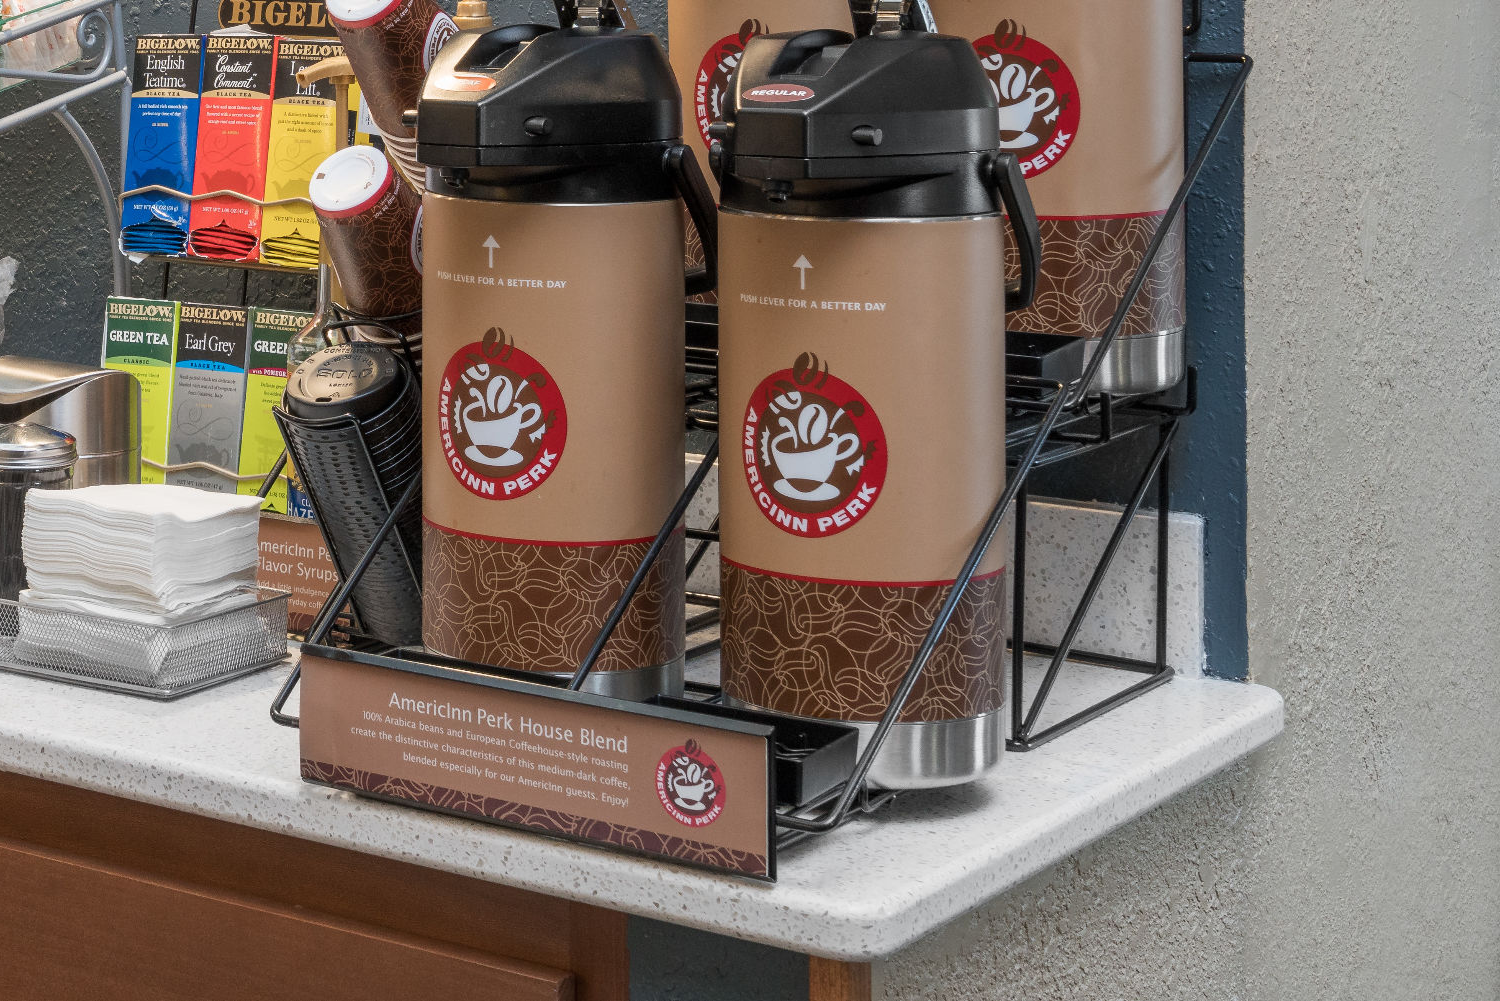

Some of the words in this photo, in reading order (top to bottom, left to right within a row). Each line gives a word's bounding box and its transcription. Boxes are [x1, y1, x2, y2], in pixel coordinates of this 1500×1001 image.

[228, 0, 336, 28] BIGEL
[137, 38, 197, 50] BIGELOW
[207, 37, 270, 50] BIGELOW
[279, 44, 345, 56] BIGELOW
[146, 55, 185, 72] English
[144, 72, 184, 88] Teatime
[751, 89, 807, 97] REGULAR
[1019, 130, 1071, 175] PERK
[454, 273, 475, 284] LEVER
[478, 277, 495, 285] FOR
[498, 278, 504, 286] A
[507, 279, 542, 288] BETTER
[546, 280, 567, 288] DAY
[109, 303, 170, 318] BIGELOW
[740, 294, 757, 303] PUSH
[759, 296, 785, 306] LEVER
[788, 299, 807, 308] FOR
[810, 300, 817, 309] A
[821, 301, 861, 311] BETTER
[865, 302, 887, 311] DAY
[181, 306, 243, 321] BIGELOW
[109, 330, 144, 344] GREEN
[146, 332, 169, 346] TEA
[185, 332, 207, 350] Earl
[208, 336, 236, 356] Grey
[440, 377, 495, 495] AMERICINN
[503, 448, 557, 495] PERK
[745, 406, 807, 532] AMERICINN
[817, 482, 877, 532] PERK
[318, 547, 332, 561] Pe
[297, 563, 339, 582] Syrups
[388, 692, 472, 723] AmericInn
[477, 708, 513, 731] Perk
[520, 716, 573, 743] House
[580, 728, 628, 753] Blend
[362, 710, 382, 722] 100%
[384, 715, 416, 729] Arabica
[419, 720, 444, 734] beans
[447, 728, 463, 738] and
[466, 730, 506, 746] European
[508, 740, 588, 764] Coffeehouse-style
[591, 757, 629, 774] roasting
[350, 726, 376, 738] create
[379, 730, 392, 741] the
[395, 734, 439, 750] distinctive
[441, 743, 504, 764] characteristics
[506, 757, 517, 766] of
[518, 758, 535, 770] this
[537, 763, 597, 783] medium-dark
[599, 775, 631, 790] coffee,
[403, 751, 437, 767] blended
[440, 759, 482, 778] especially
[484, 768, 497, 779] for
[500, 773, 515, 783] our
[517, 776, 563, 793] AmericInn
[565, 786, 599, 801] guests.
[601, 792, 629, 808] Enjoy!
[657, 762, 691, 824] AMERICINN
[695, 805, 721, 826] PERK
